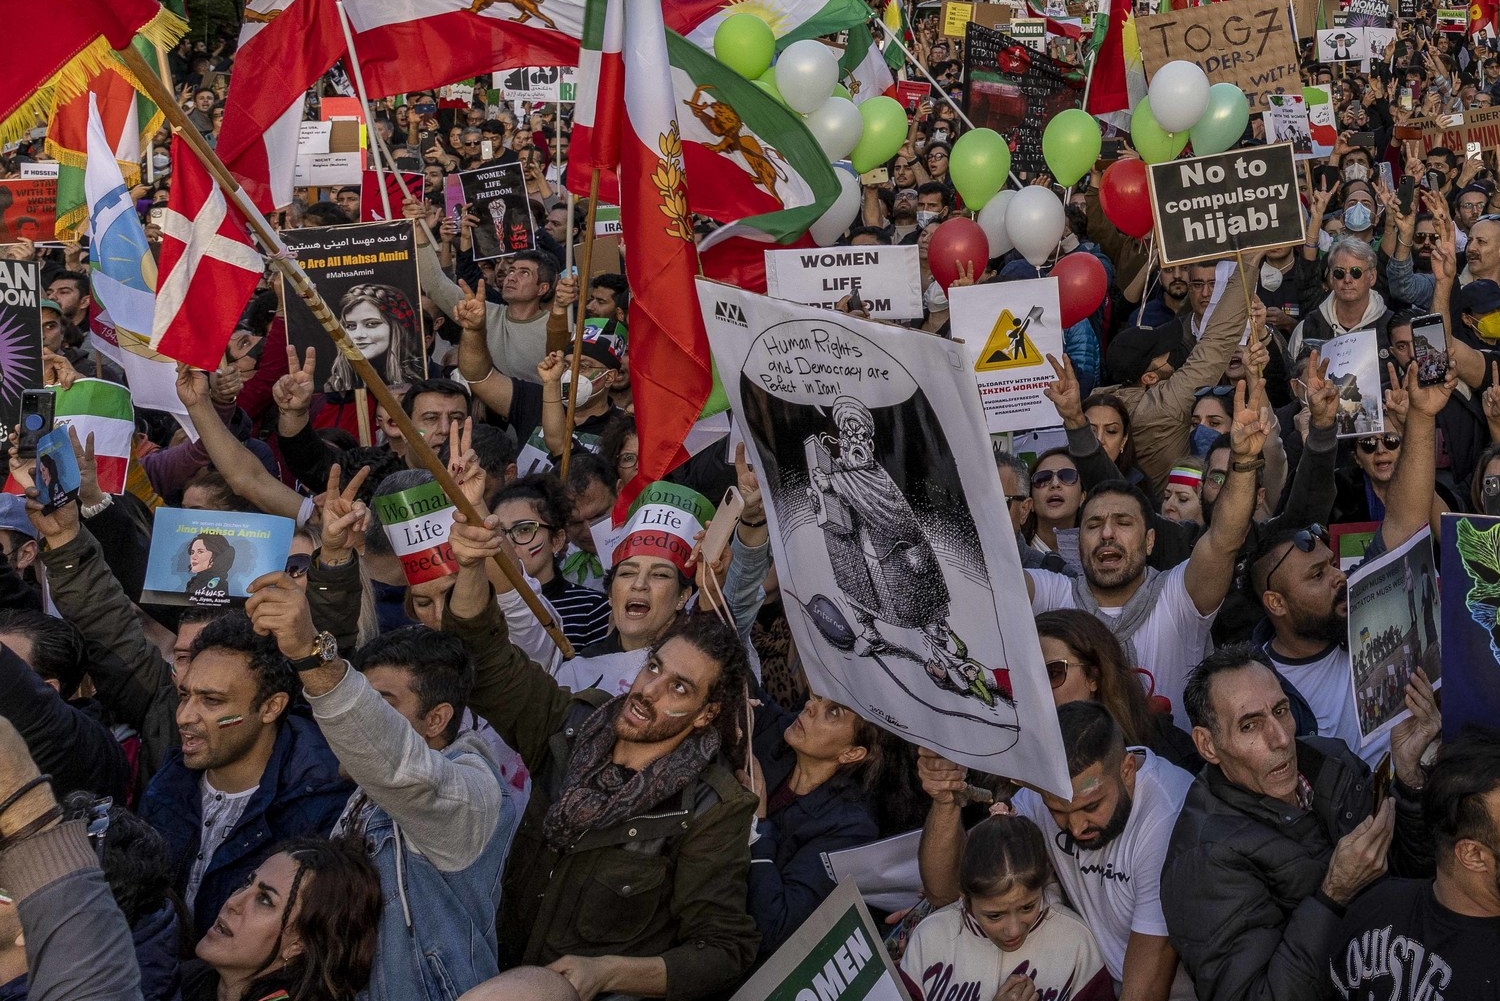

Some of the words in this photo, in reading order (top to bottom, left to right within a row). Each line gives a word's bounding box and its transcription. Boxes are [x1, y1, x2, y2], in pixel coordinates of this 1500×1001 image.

[1351, 0, 1389, 13] WOMAN
[1012, 25, 1043, 34] WOMEN
[1150, 21, 1212, 57] TO
[1223, 7, 1283, 57] G7
[1196, 51, 1257, 75] DERS
[1250, 63, 1296, 88] WITH
[1423, 130, 1463, 151] MHSA
[1467, 124, 1500, 149] AMINI
[477, 170, 506, 181] WOMEN
[1179, 162, 1225, 188] No
[1234, 157, 1267, 179] to
[484, 181, 501, 189] LIFE
[476, 187, 513, 200] FREEDOM
[1165, 183, 1290, 214] compulsory
[1182, 203, 1280, 244] hijab!
[352, 237, 375, 247] مهسا
[377, 235, 397, 243] همه
[399, 233, 408, 241] ما
[286, 243, 321, 255] هستیم
[323, 238, 350, 251] امینی
[308, 257, 326, 269] Are
[327, 255, 342, 268] All
[342, 254, 378, 266] Mahsa
[378, 250, 409, 263] Amini
[800, 252, 879, 269] WOMEN
[326, 268, 375, 279] #MahsaAmini
[822, 277, 862, 291] LIFE
[762, 335, 811, 357] Human
[811, 328, 863, 359] Rights
[768, 360, 793, 374] and
[794, 357, 863, 381] Democracy
[867, 367, 889, 381] are
[760, 374, 797, 394] Perfect
[802, 379, 815, 394] in
[815, 379, 842, 395] Iran!
[1032, 374, 1055, 382] IRAN'S
[1013, 381, 1051, 392] WORKER
[984, 394, 1040, 405] #WOMANLIFEFREEDOM
[995, 407, 1031, 416] #MAHSAAMINI
[642, 509, 683, 529] Life
[176, 525, 197, 534] Jina
[200, 527, 235, 536] Mahsa
[237, 528, 271, 539] Amini
[403, 520, 445, 548] Life
[1369, 575, 1386, 588] MUSS
[1349, 593, 1375, 614] DIKTATOR
[1376, 585, 1393, 598] MUSS
[812, 604, 846, 631] Internet
[922, 962, 981, 1001] New
